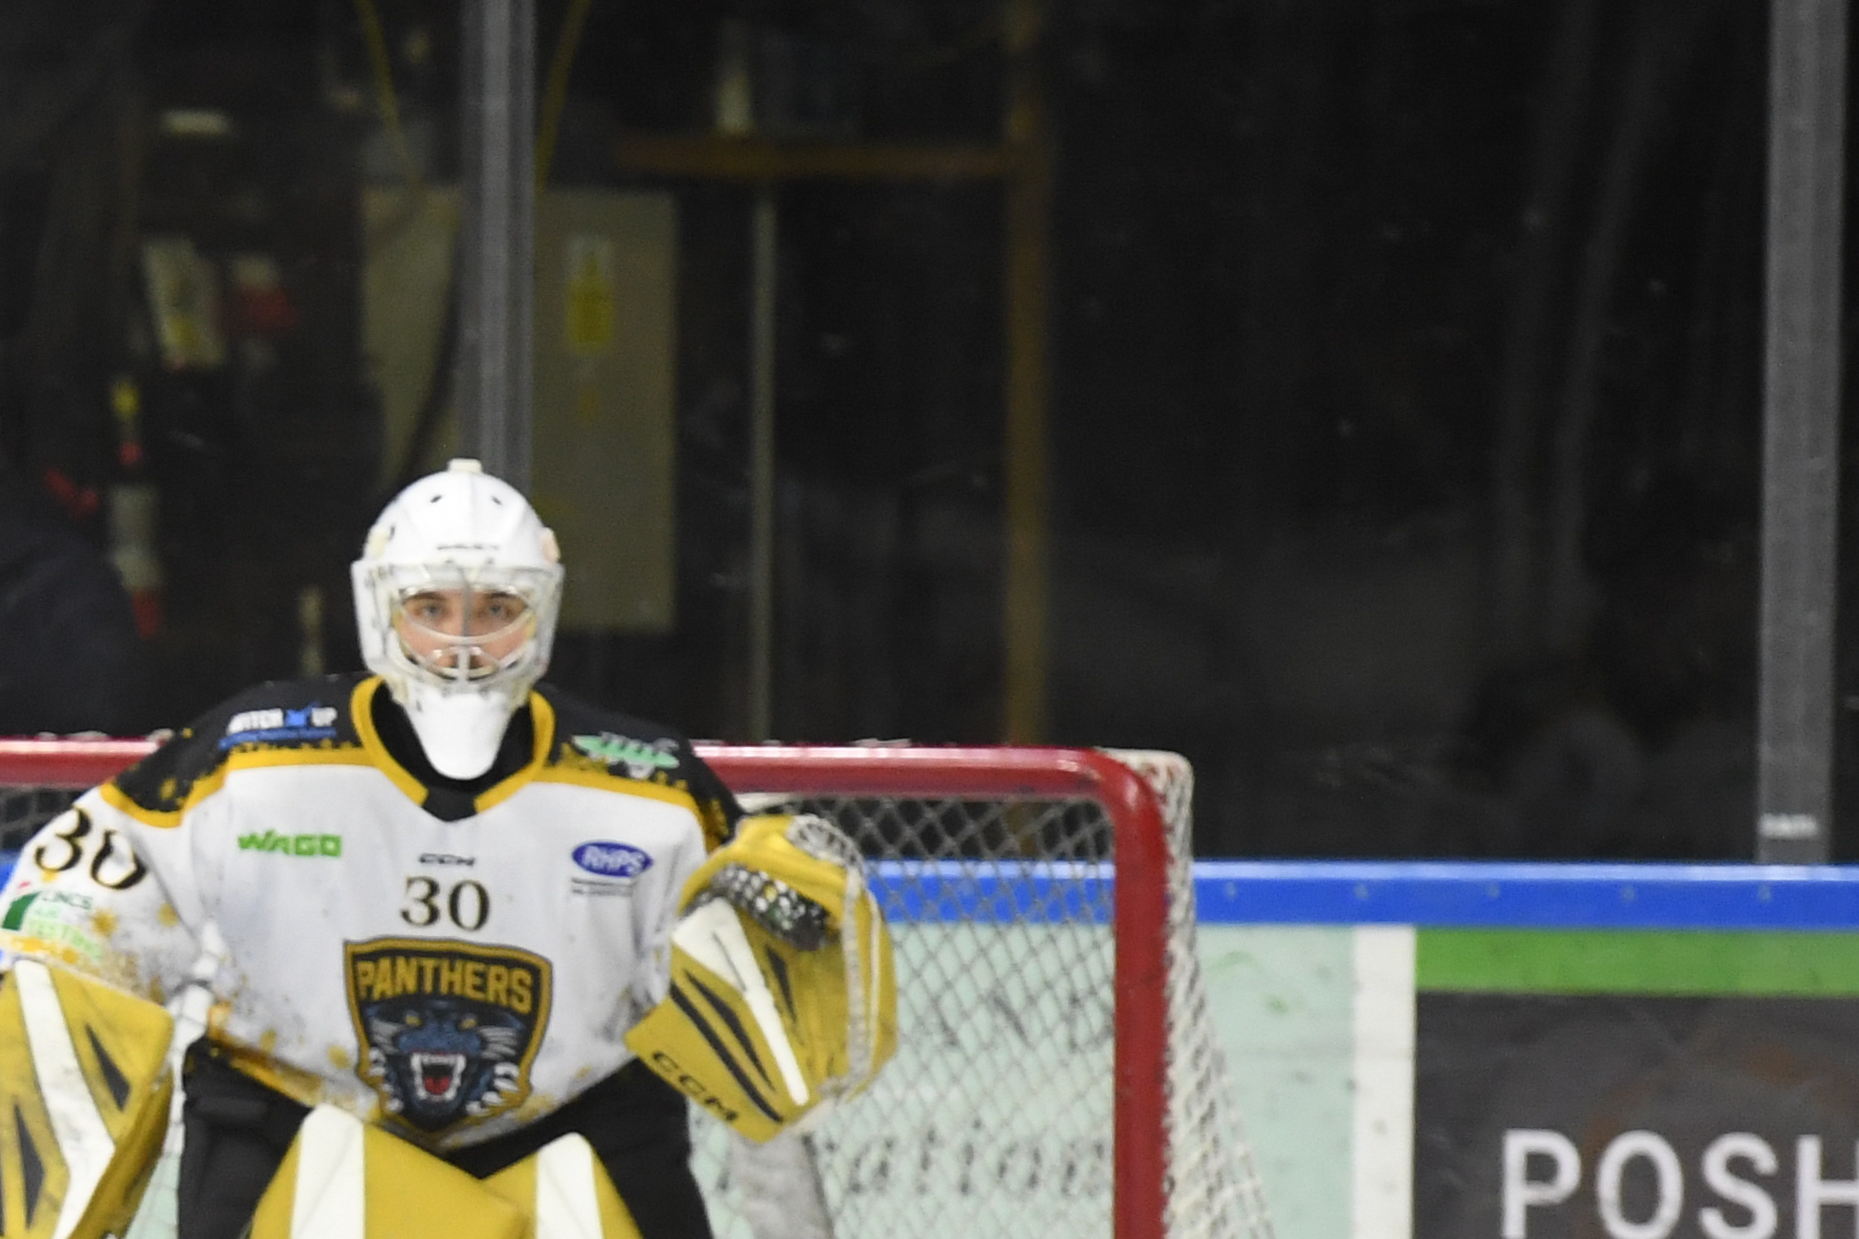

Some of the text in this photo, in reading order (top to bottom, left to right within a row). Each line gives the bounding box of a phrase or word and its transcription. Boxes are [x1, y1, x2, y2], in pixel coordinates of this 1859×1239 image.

[34, 804, 148, 890] 30
[237, 829, 342, 857] WAGO
[400, 875, 490, 932] 30
[356, 956, 534, 1015] PANTHERS
[652, 1050, 739, 1121] CCM
